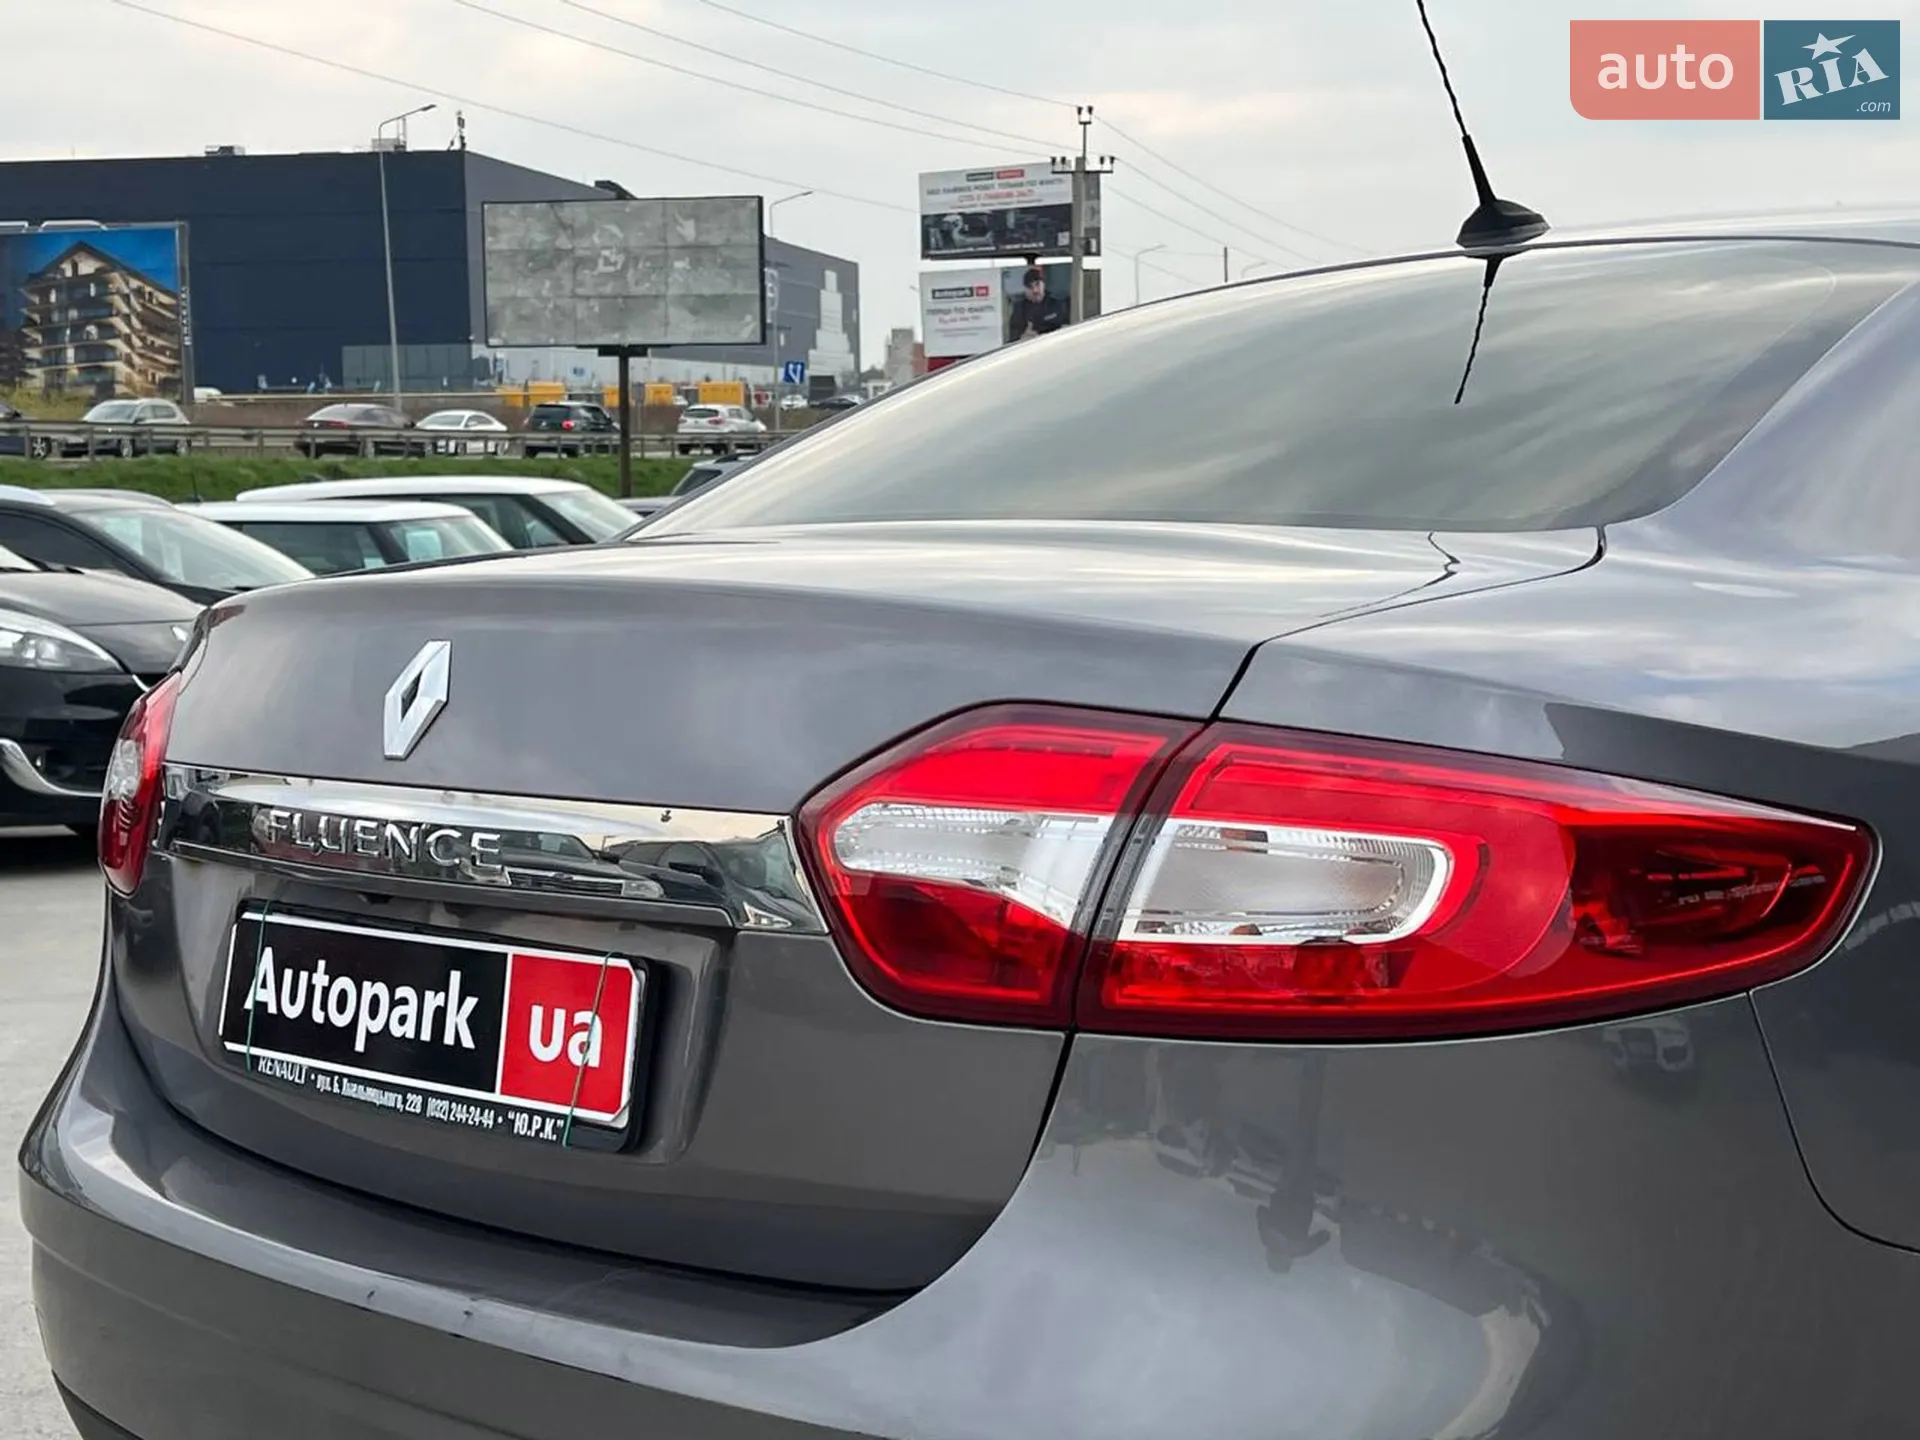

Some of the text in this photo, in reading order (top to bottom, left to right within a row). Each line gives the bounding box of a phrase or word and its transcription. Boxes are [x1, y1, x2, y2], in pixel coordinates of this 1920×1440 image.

[268, 809, 501, 868] FLUENCE
[243, 946, 602, 1069] Autopark ua
[258, 1056, 309, 1084] RENAULT
